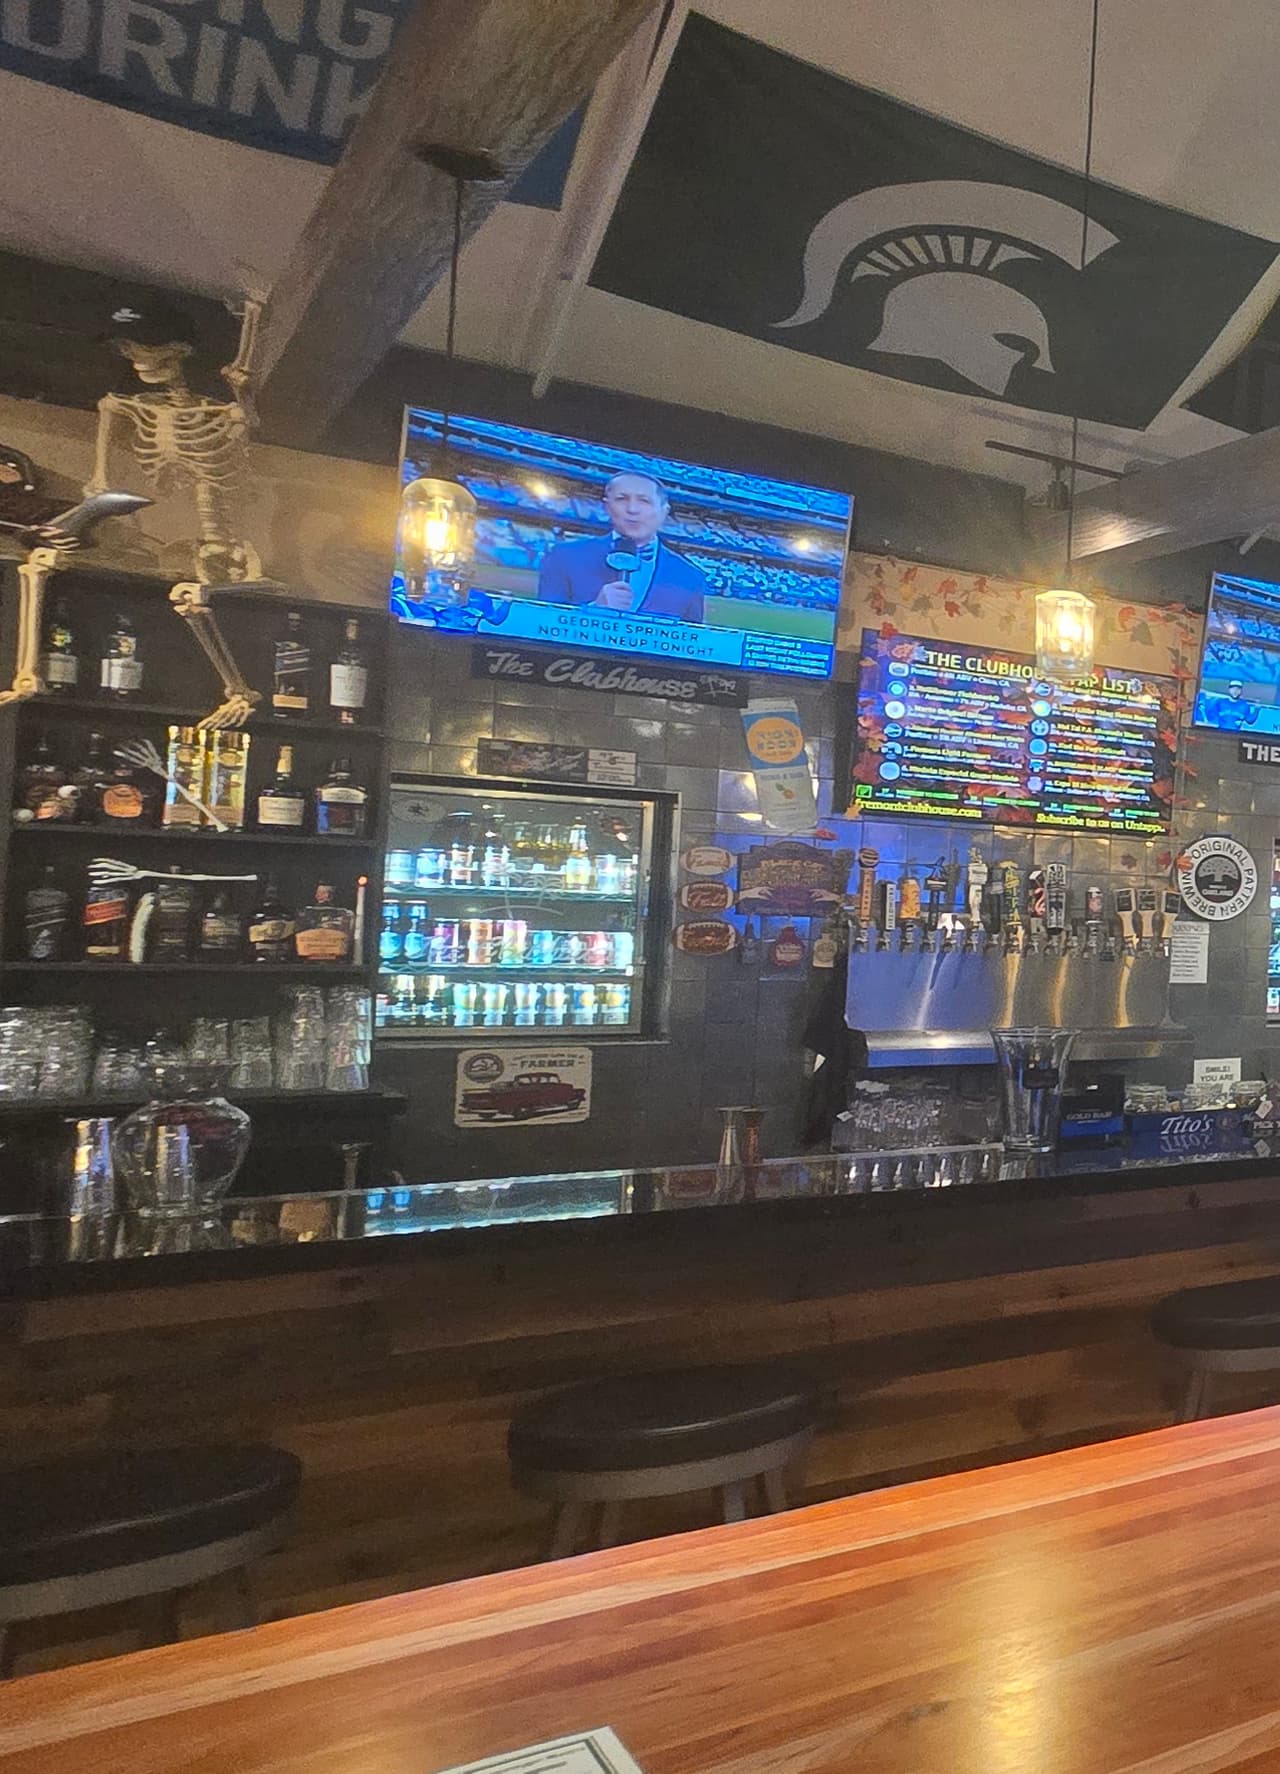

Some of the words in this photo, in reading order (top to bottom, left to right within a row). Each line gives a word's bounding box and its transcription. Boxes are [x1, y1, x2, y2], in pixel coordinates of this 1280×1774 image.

[538, 625, 569, 638] NOT
[573, 629, 589, 640] IN
[594, 633, 648, 647] LINEUP
[653, 641, 714, 656] TONIGHT
[558, 615, 620, 632] GEORGE
[625, 624, 699, 642] SPRINGER
[486, 651, 533, 676] The
[543, 658, 698, 698] Clubhouse
[927, 651, 961, 669] THE
[965, 657, 1062, 683] CLUBHOU
[1103, 678, 1132, 693] LIST
[1036, 813, 1084, 826] Subscribe
[1192, 841, 1248, 866] ORIGINAL
[1182, 870, 1216, 916] BREWIN
[1219, 868, 1254, 917] PATTERN
[1160, 1114, 1214, 1135] Tito's
[1253, 1120, 1274, 1129] PICK
